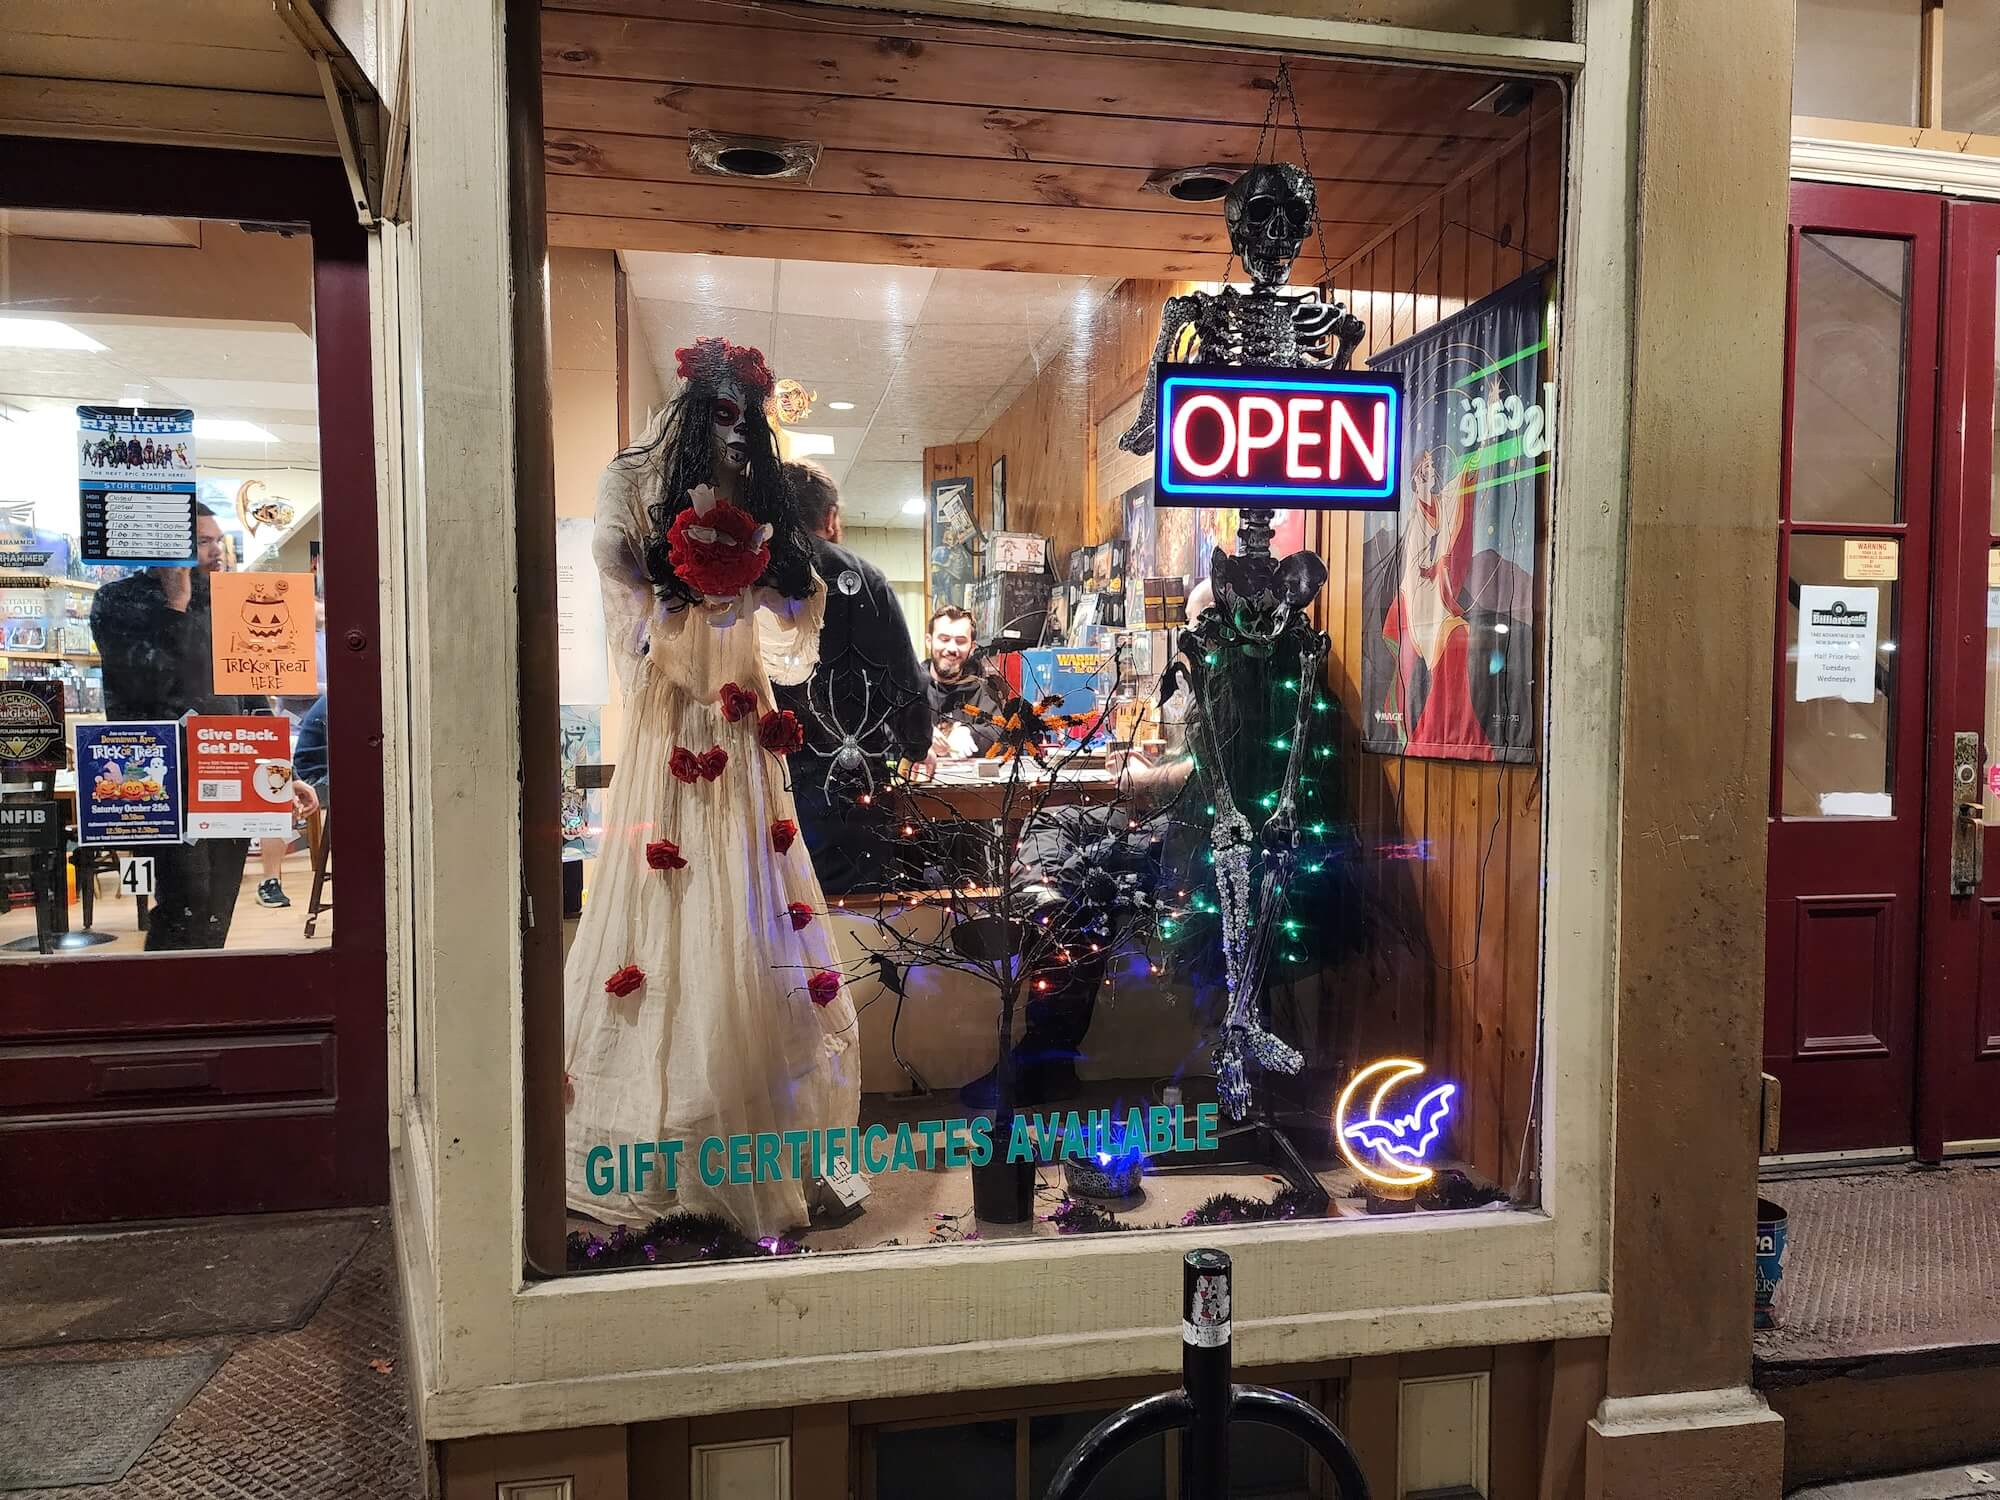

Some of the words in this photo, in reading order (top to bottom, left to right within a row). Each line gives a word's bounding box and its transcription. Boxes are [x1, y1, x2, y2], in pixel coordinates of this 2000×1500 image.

[81, 420, 192, 433] REBIRTH
[1172, 394, 1386, 481] OPEN
[141, 483, 173, 491] HOURS
[1812, 613, 1851, 625] Billiards
[260, 661, 270, 669] OR
[1823, 664, 1851, 672] Tuesdays
[251, 676, 283, 690] HERE
[1817, 674, 1856, 683] Wednesdays
[101, 735, 138, 743] Downtown
[197, 729, 232, 740] Give
[235, 729, 278, 740] Back.
[121, 747, 132, 756] OR
[197, 743, 227, 754] Get
[229, 743, 258, 754] Pie.
[91, 804, 123, 814] Saturday
[124, 803, 151, 812] October
[0, 809, 46, 824] NFIB
[123, 860, 152, 892] 41
[585, 1139, 684, 1196] GIFT
[698, 1115, 993, 1187] CERTIFICATES
[1006, 1102, 1218, 1165] AVAILABLE
